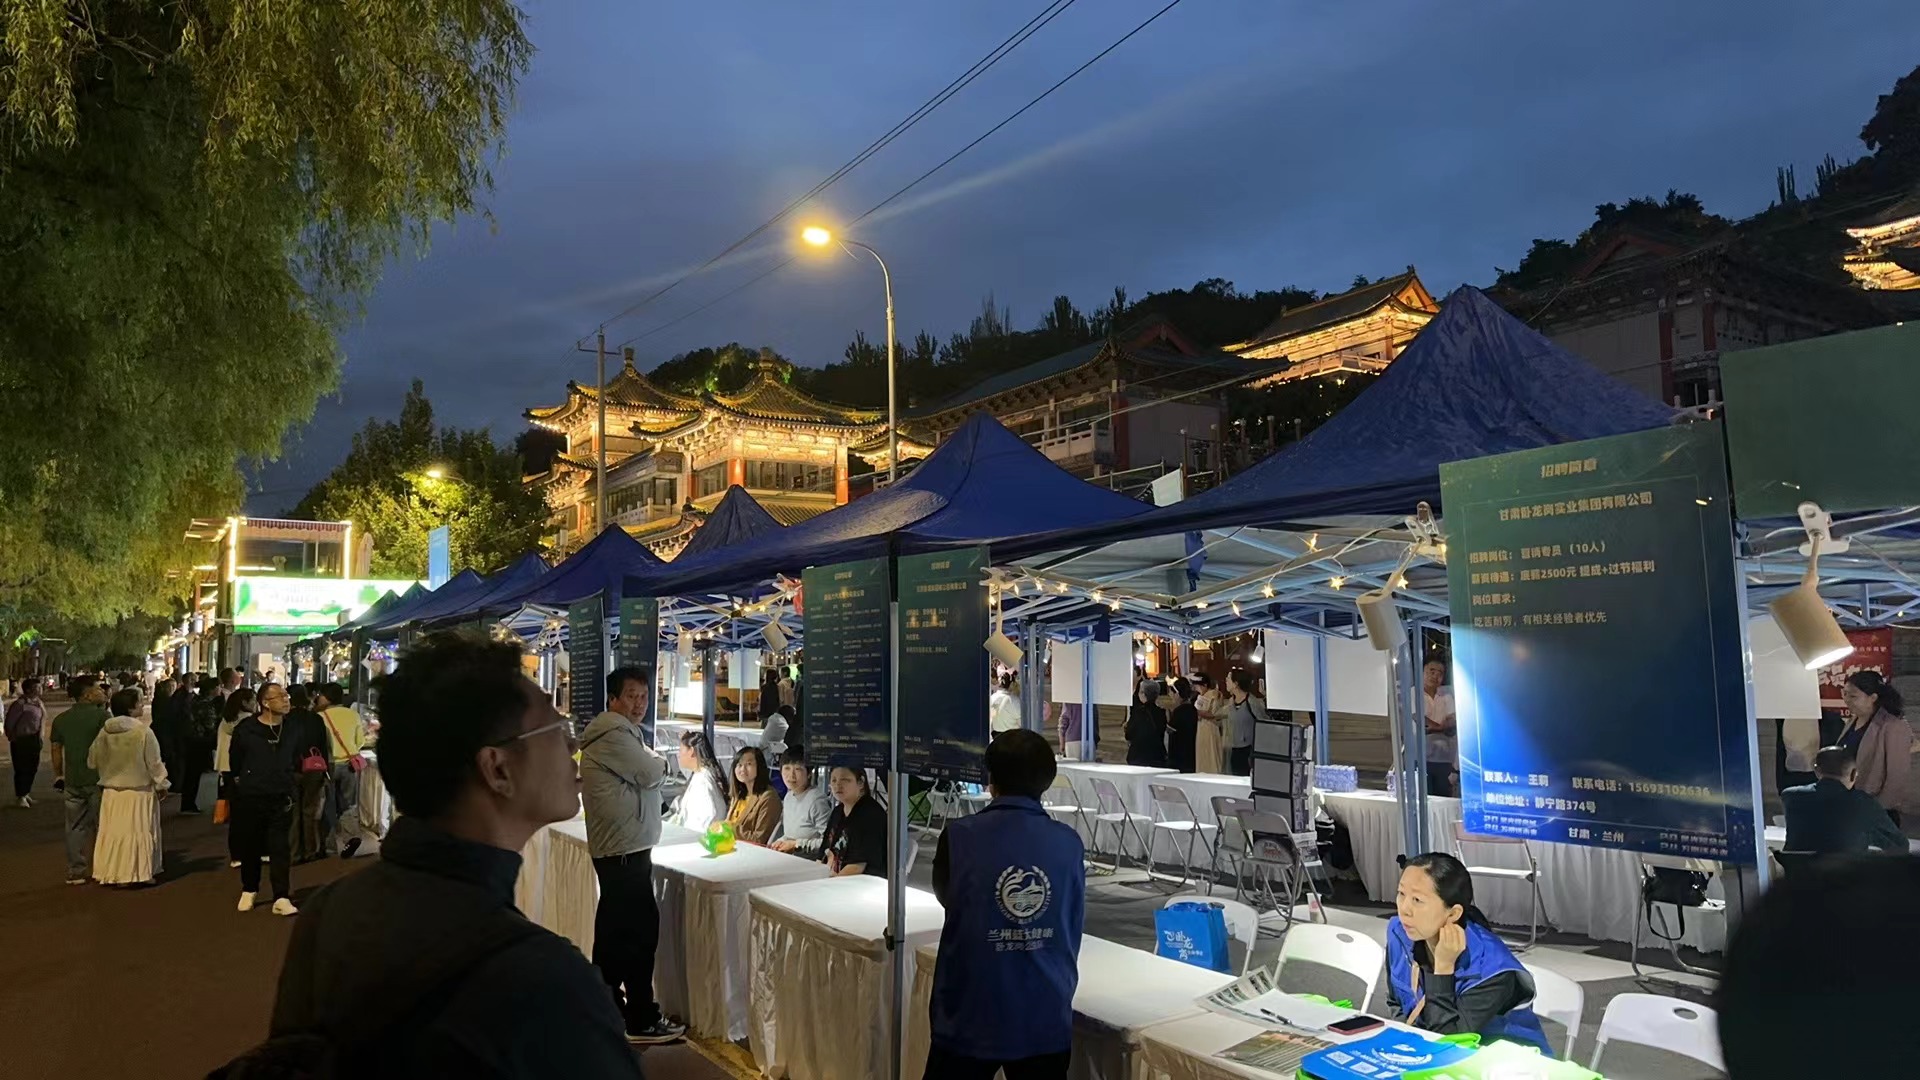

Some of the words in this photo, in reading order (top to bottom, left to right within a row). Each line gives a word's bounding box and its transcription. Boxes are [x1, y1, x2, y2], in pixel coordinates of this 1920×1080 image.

[1541, 458, 1597, 478] 招聘简章
[1499, 491, 1652, 521] 甘肃卧龙岗实业集团有限公司
